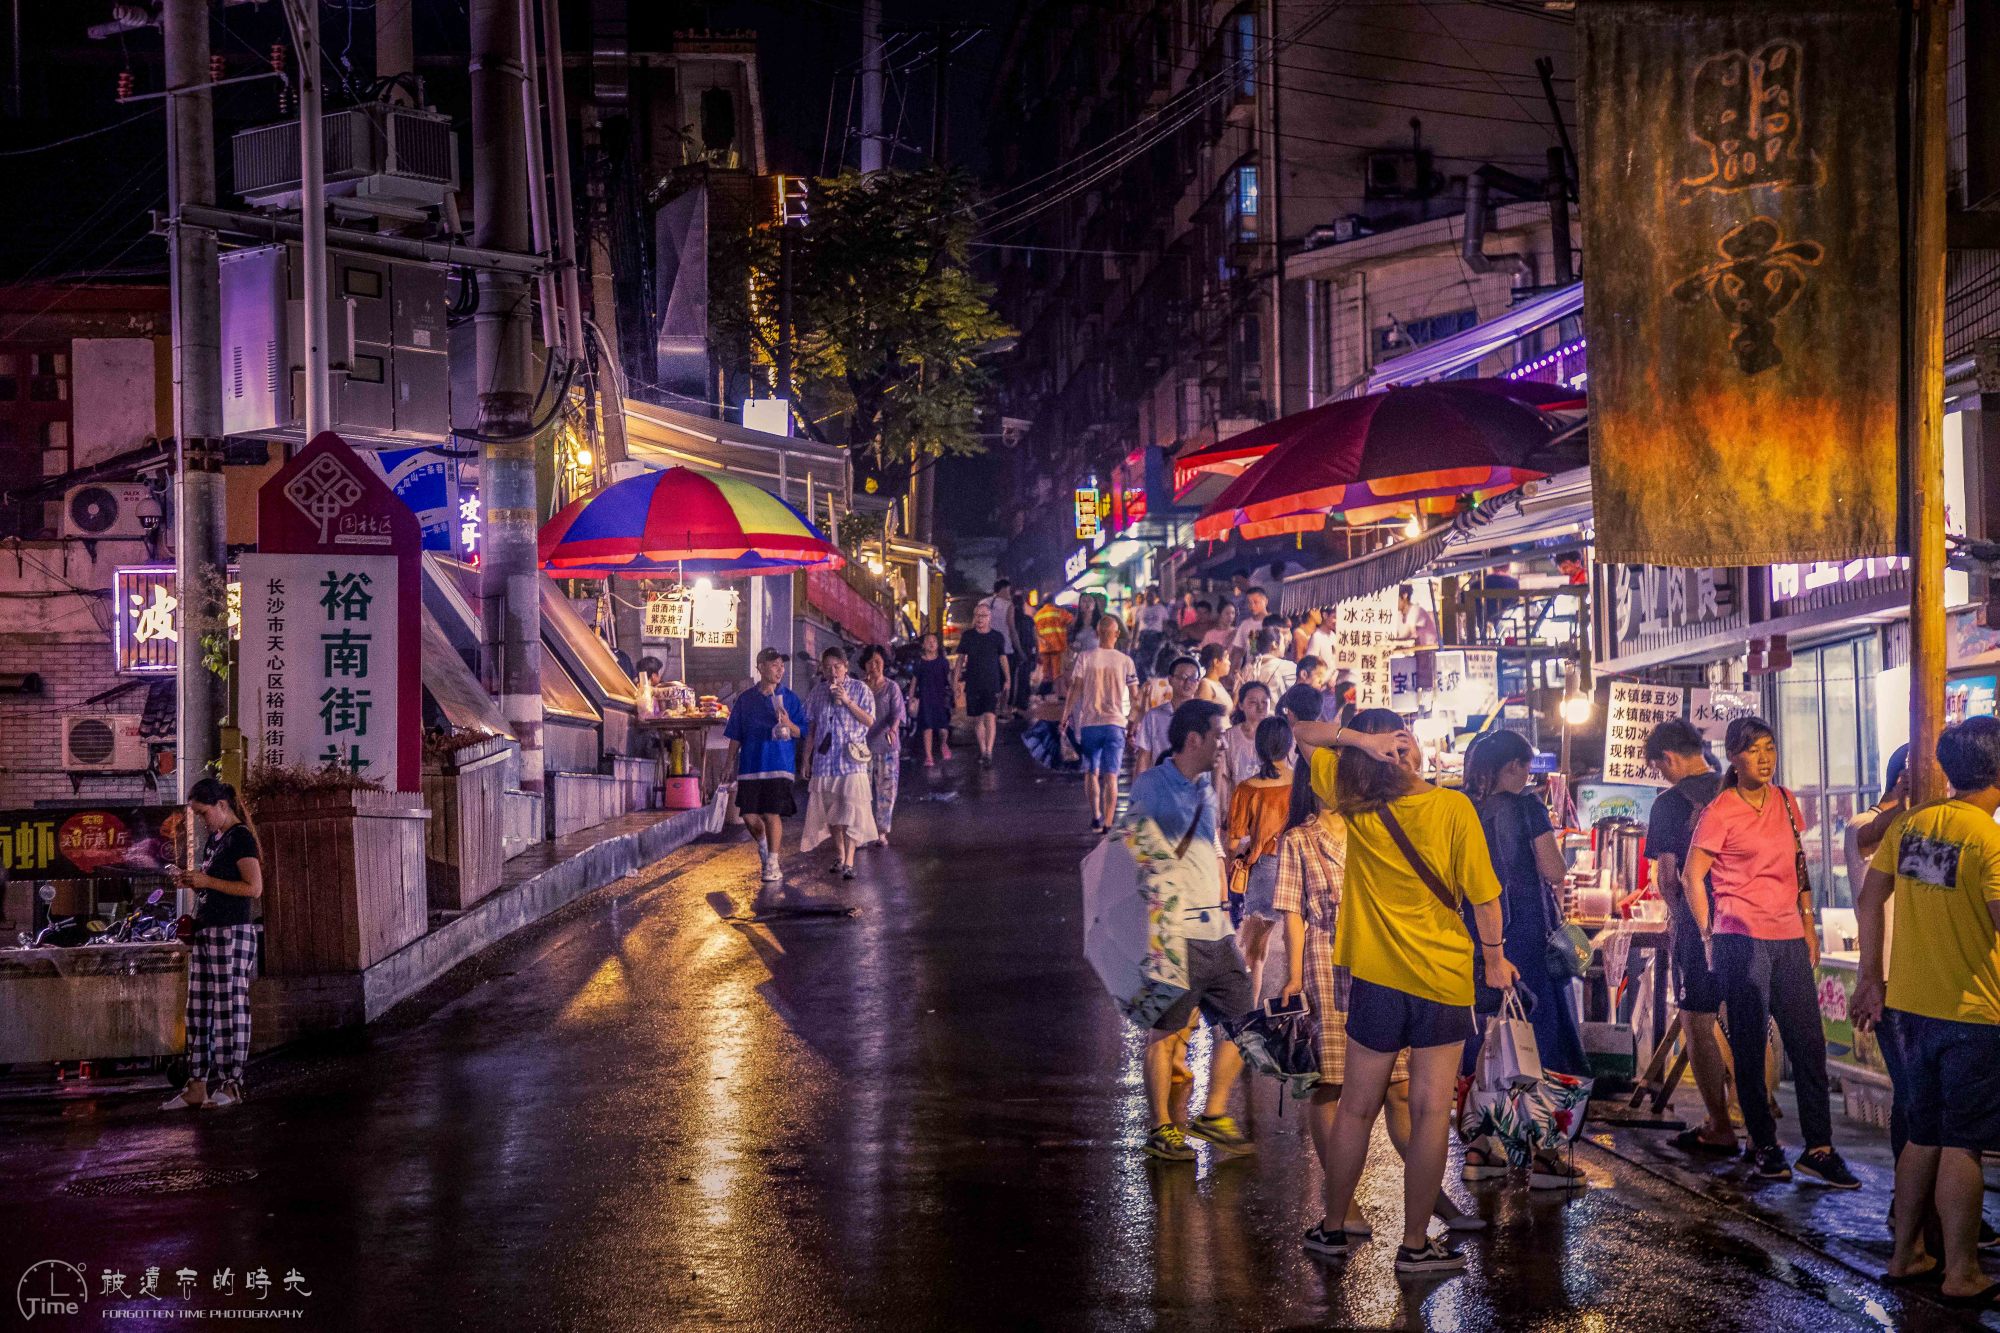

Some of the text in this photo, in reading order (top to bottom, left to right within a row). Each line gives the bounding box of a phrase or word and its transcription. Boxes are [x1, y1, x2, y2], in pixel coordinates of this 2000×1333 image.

[1614, 688, 1680, 707] 冰镇绿豆沙
[1613, 706, 1678, 724] 冰镇酸梅汤
